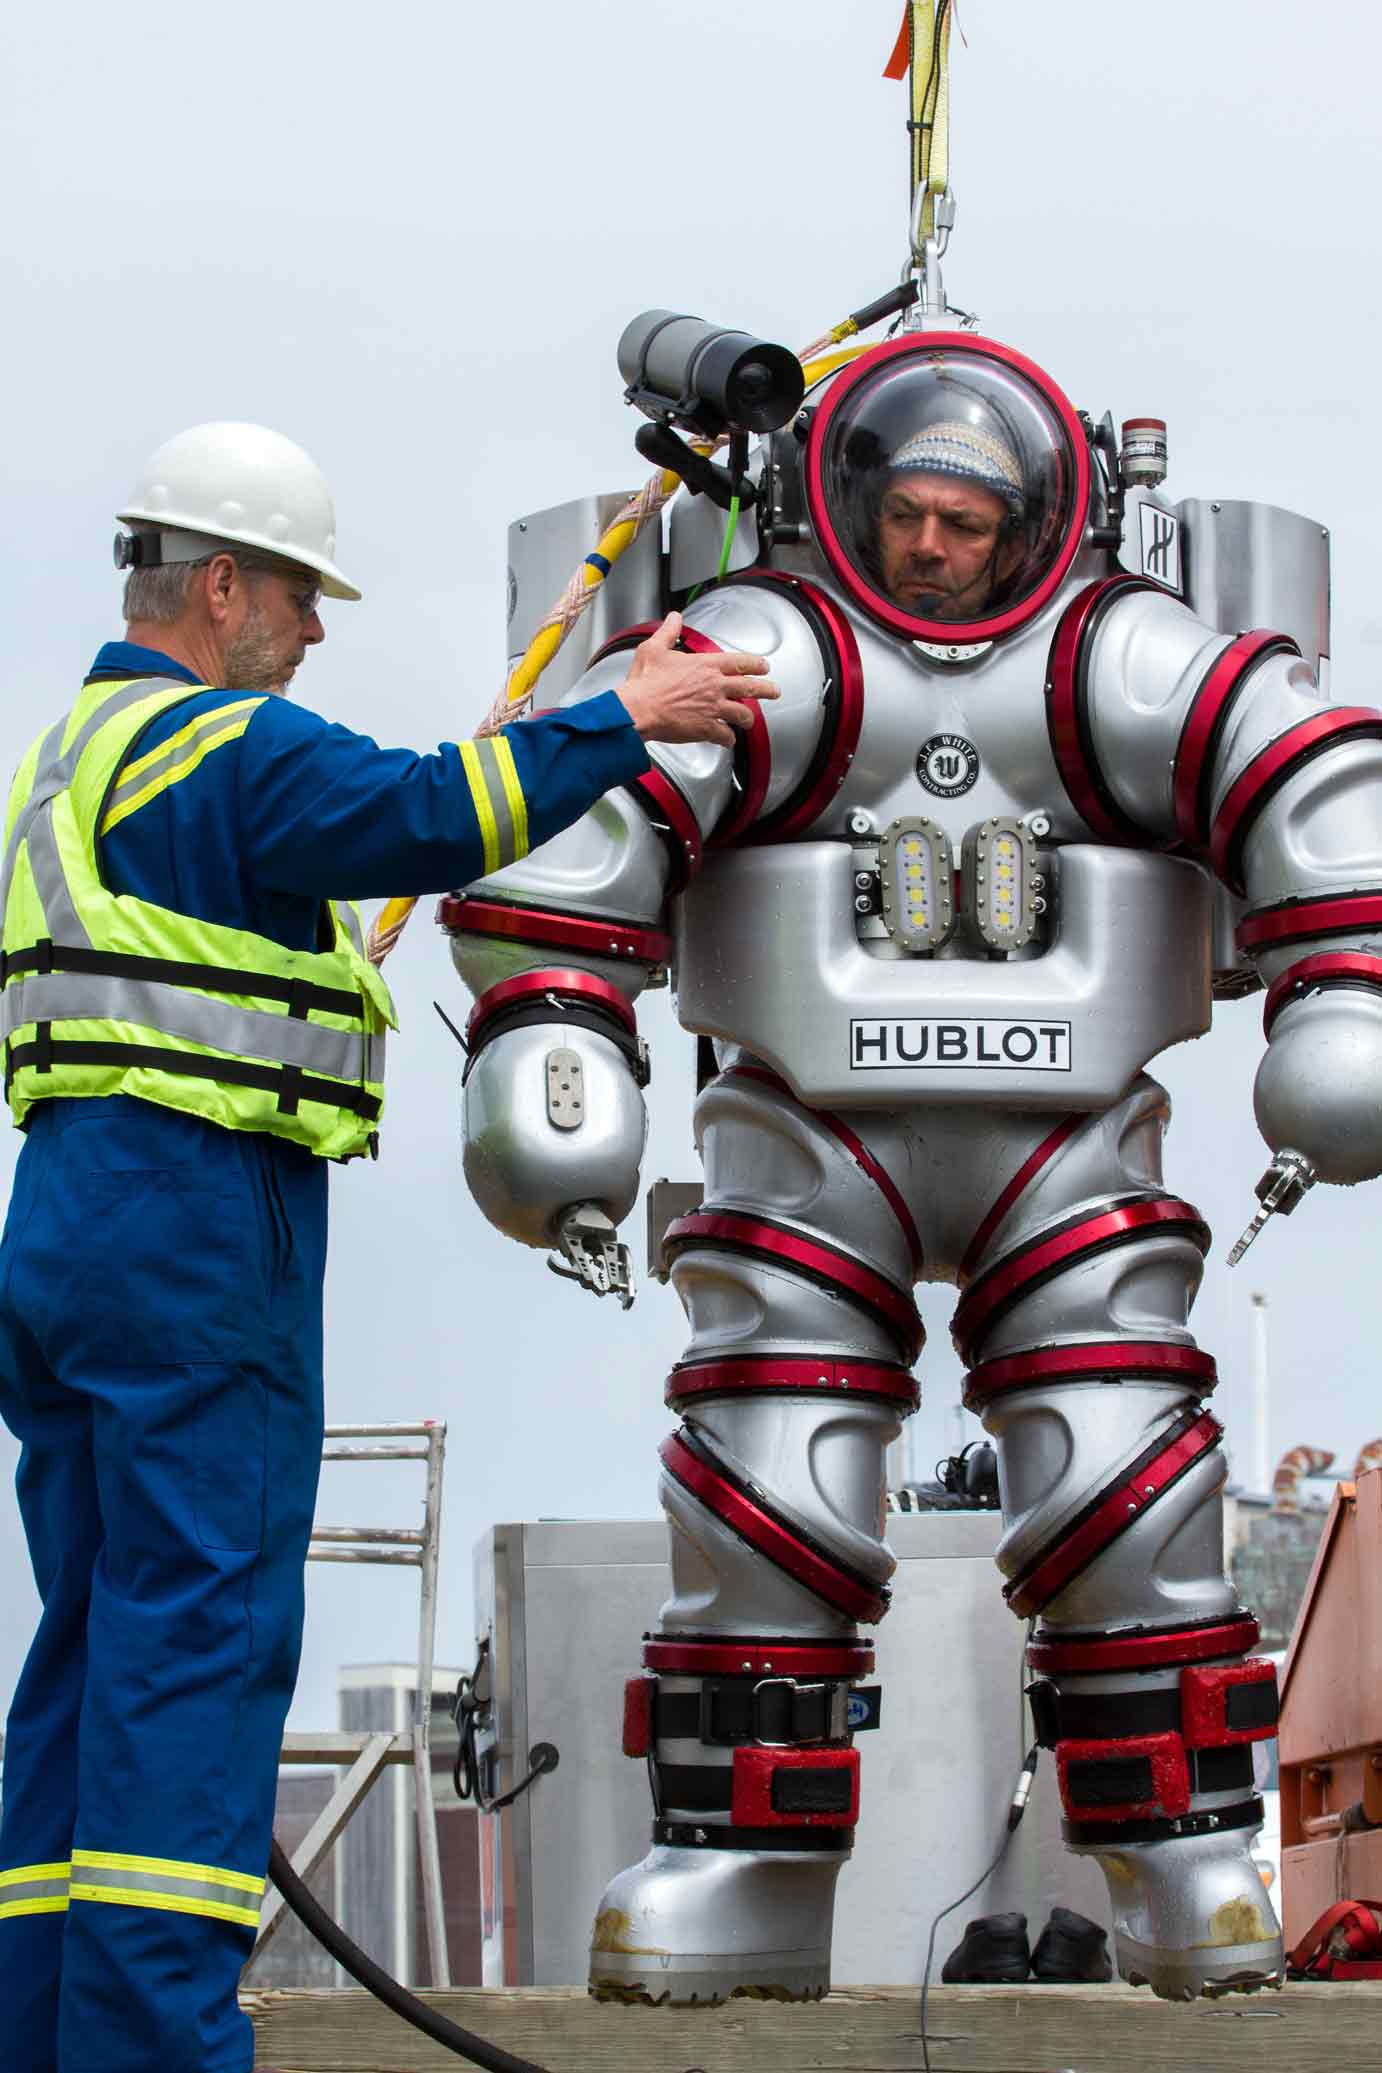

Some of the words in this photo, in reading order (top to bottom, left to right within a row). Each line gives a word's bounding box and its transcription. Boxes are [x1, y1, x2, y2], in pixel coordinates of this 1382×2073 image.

[941, 736, 977, 762] WHITE
[919, 769, 968, 796] CONTRACTING
[855, 1025, 1066, 1063] HUBLOT
